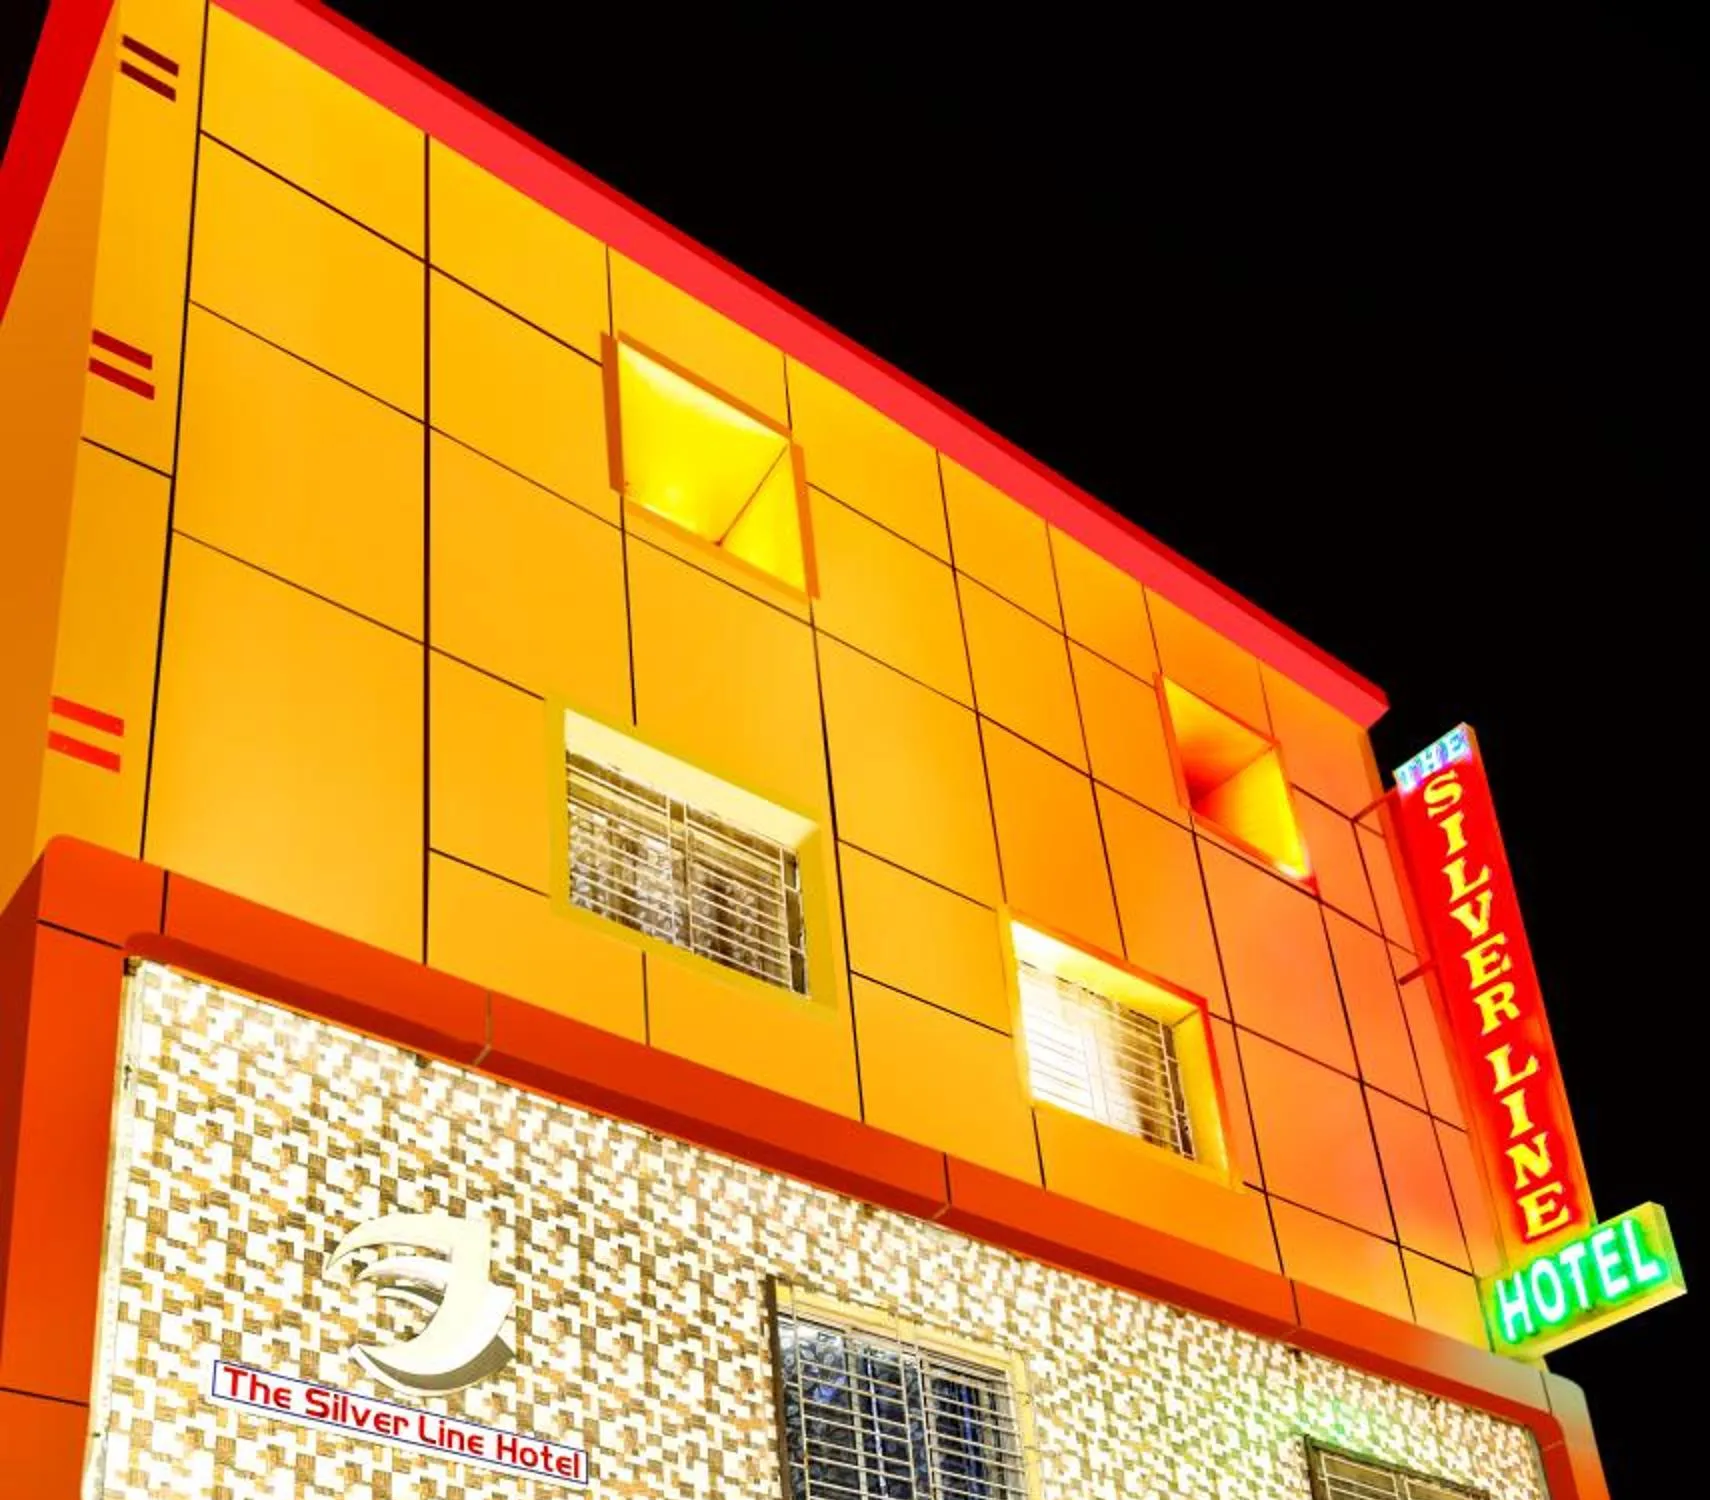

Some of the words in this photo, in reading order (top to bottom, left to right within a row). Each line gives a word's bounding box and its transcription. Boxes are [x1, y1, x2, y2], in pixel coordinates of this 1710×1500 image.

[1399, 730, 1467, 793] THE
[1423, 770, 1520, 1035] SILVER
[1485, 1043, 1571, 1243] LINE
[1495, 1218, 1664, 1342] HOTEL
[224, 1366, 292, 1409] The
[305, 1389, 409, 1435] Silver
[418, 1415, 484, 1455] Line
[496, 1434, 581, 1479] Hotel
